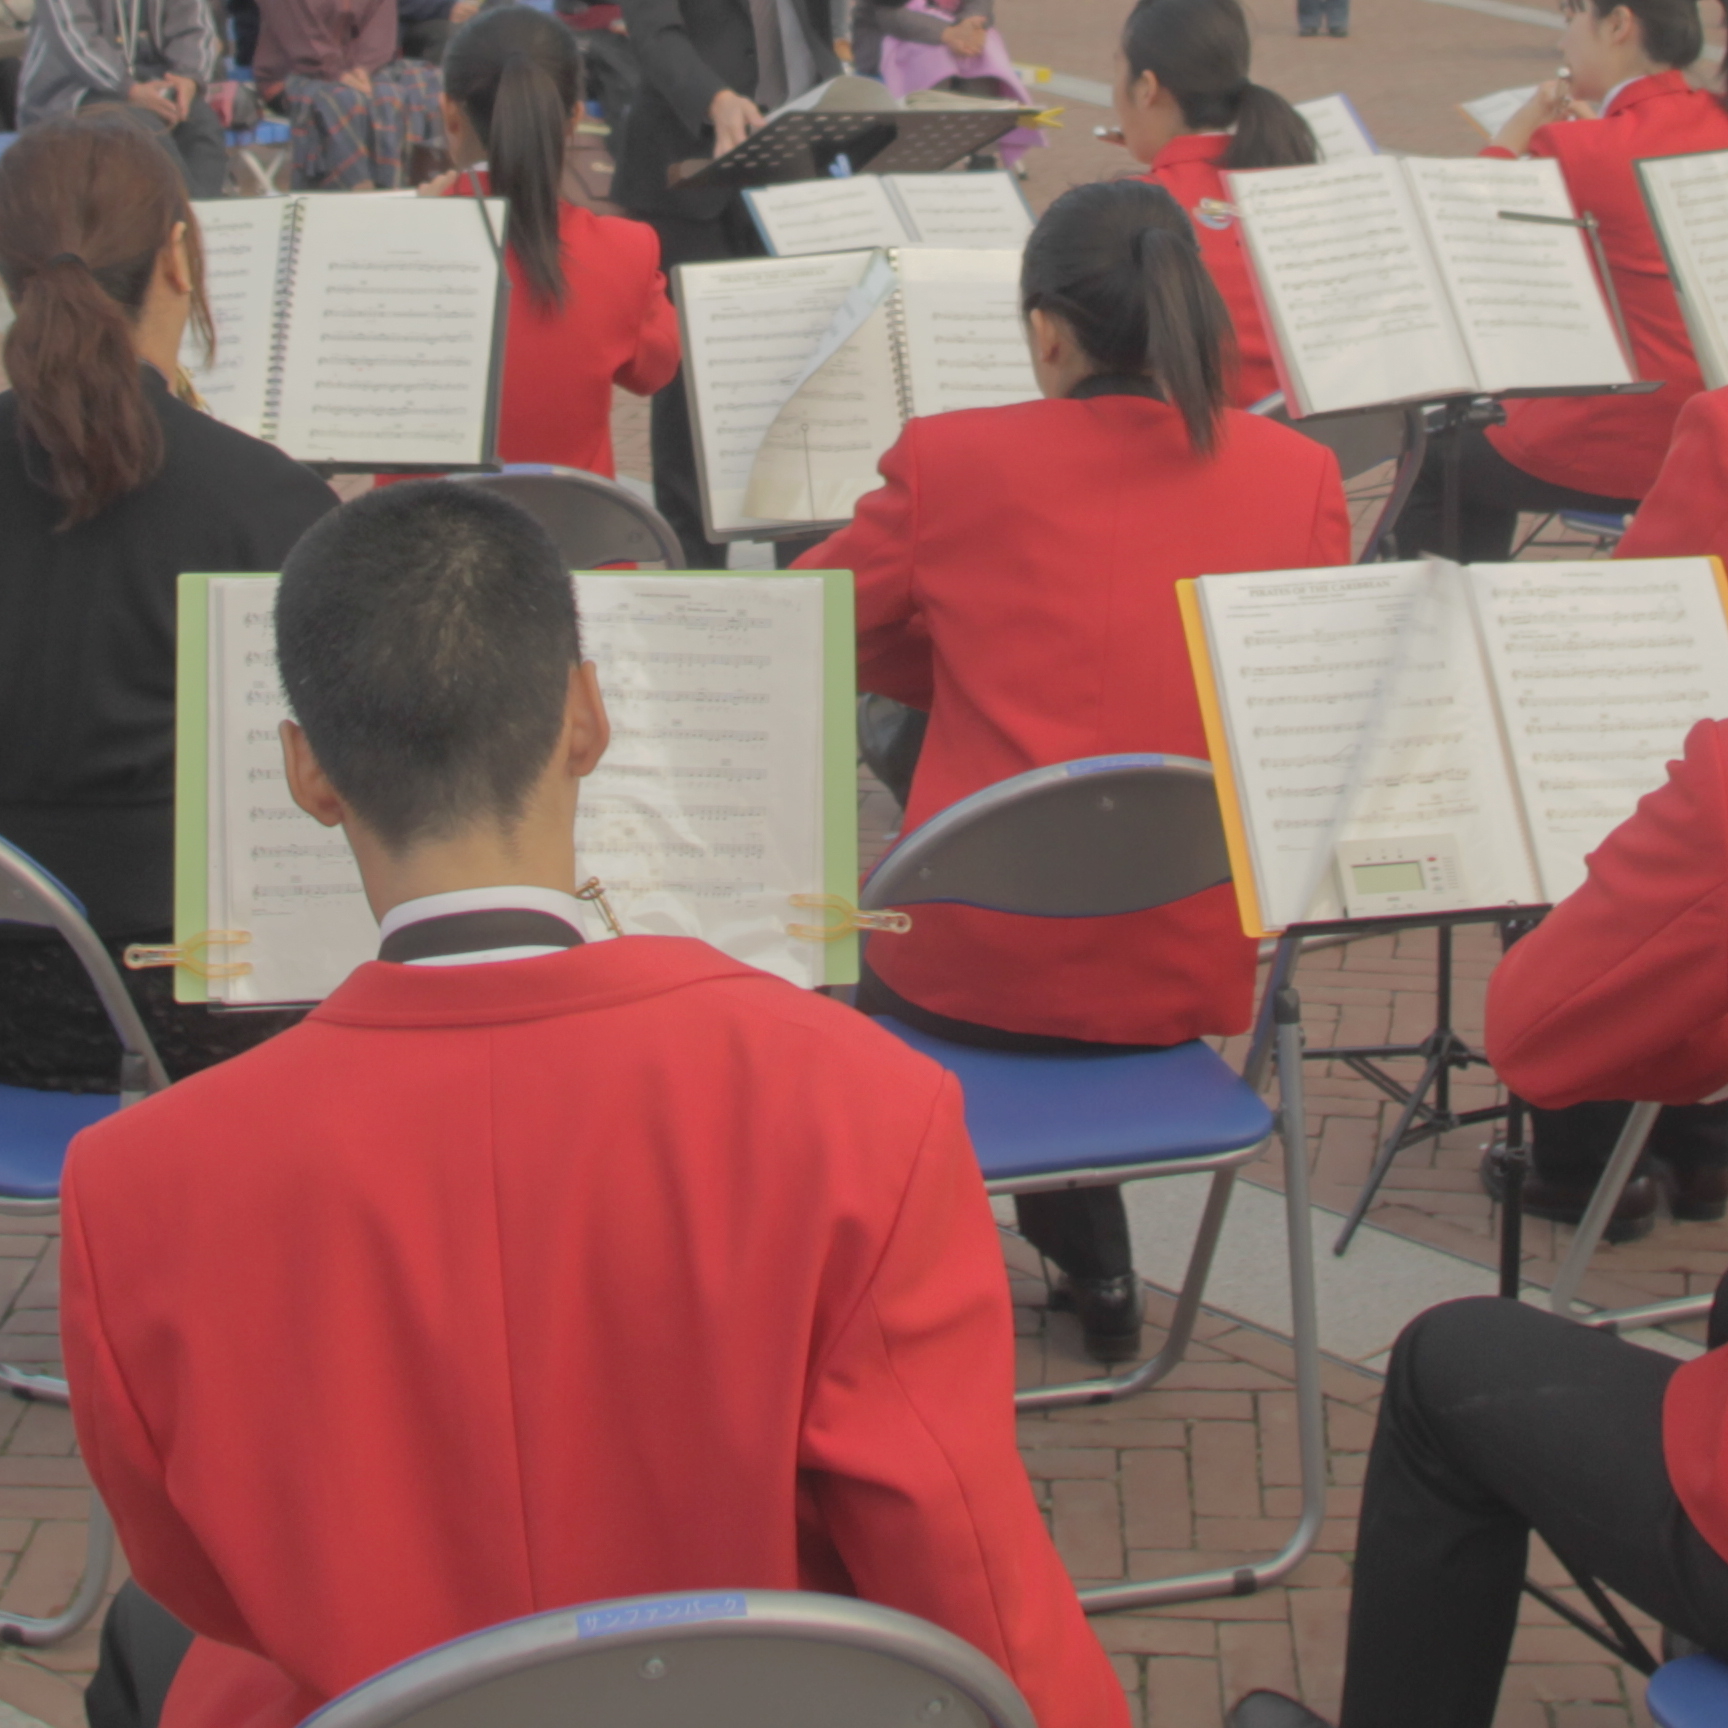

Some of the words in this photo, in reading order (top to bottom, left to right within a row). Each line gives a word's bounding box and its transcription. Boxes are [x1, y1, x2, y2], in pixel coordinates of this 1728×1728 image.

[1309, 584, 1329, 594] THE
[585, 1596, 738, 1632] サンファンパーク
